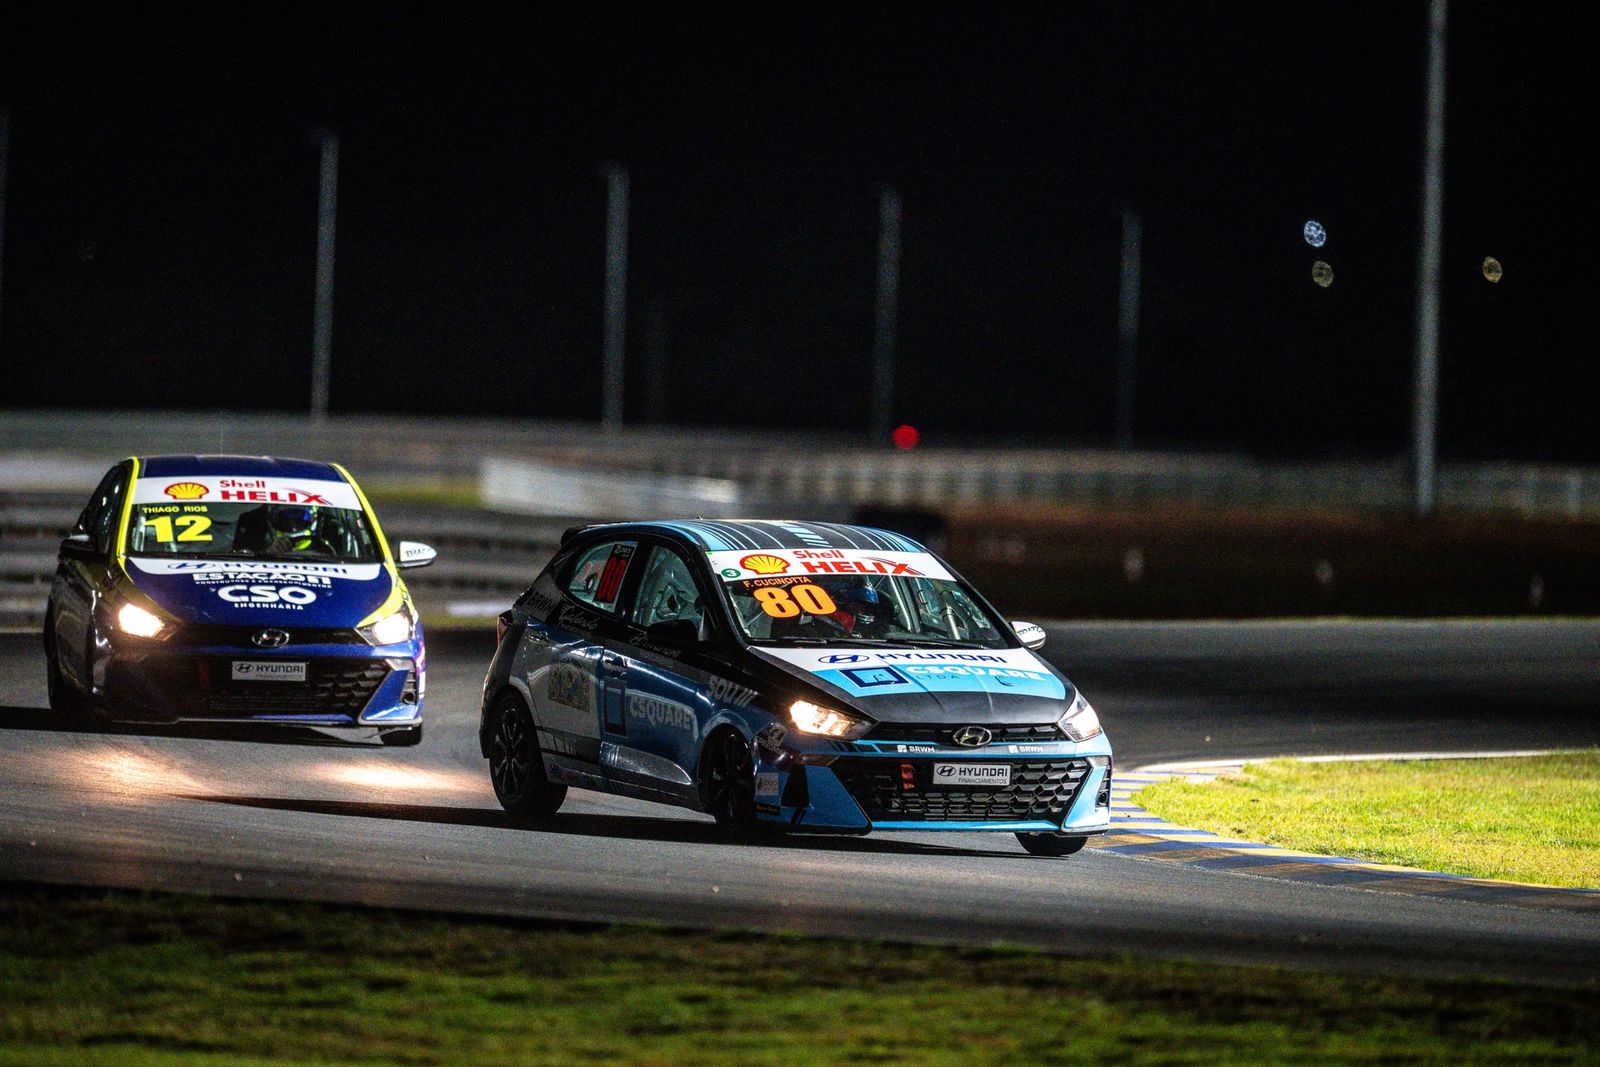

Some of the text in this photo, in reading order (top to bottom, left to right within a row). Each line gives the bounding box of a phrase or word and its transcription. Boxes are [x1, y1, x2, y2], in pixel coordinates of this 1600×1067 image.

[219, 479, 266, 489] Shell
[221, 490, 326, 505] HELIX
[142, 505, 209, 514] THIAGO RIOS
[144, 515, 213, 543] 12
[792, 550, 845, 560] Shell
[224, 563, 348, 574] HYUNDAI
[726, 568, 738, 578] 3
[801, 560, 921, 576] HELIX
[743, 576, 812, 588] F. CUCINOTTA
[217, 584, 317, 605] CSO
[234, 602, 304, 611] ENGENHARIA
[753, 584, 837, 619] 80
[875, 653, 1009, 664] HYUNDAI
[256, 665, 304, 674] HYUNDAI
[906, 663, 1046, 682] CSQUARE
[630, 693, 692, 730] CSQUARE
[909, 745, 935, 753] BRWM
[1019, 745, 1044, 753] BRWM
[958, 767, 1008, 777] HYUNDAI
[958, 777, 1008, 785] FINANCIAMENTOS
